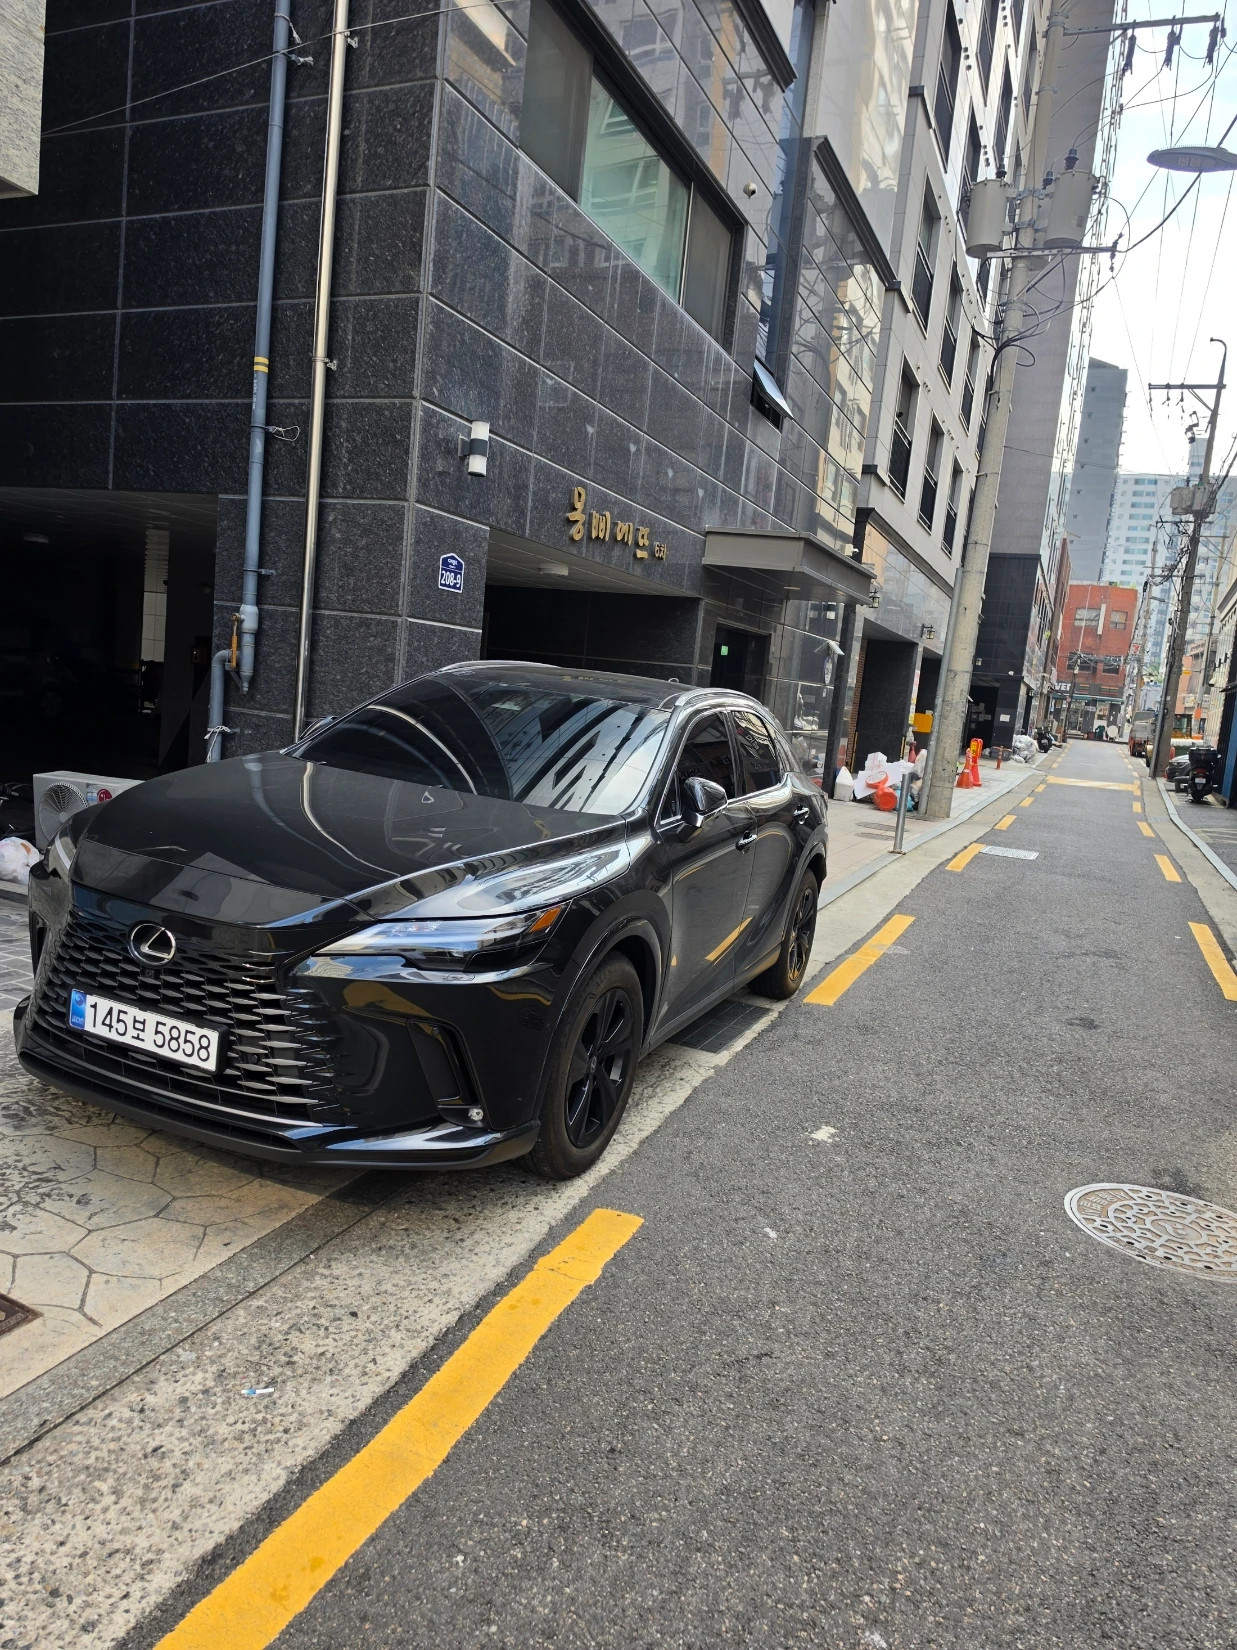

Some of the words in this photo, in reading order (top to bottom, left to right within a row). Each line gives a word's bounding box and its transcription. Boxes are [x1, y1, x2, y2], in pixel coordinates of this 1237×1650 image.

[441, 570, 461, 588] 208-9
[90, 1002, 146, 1042] 145보
[153, 1020, 211, 1062] 5858
